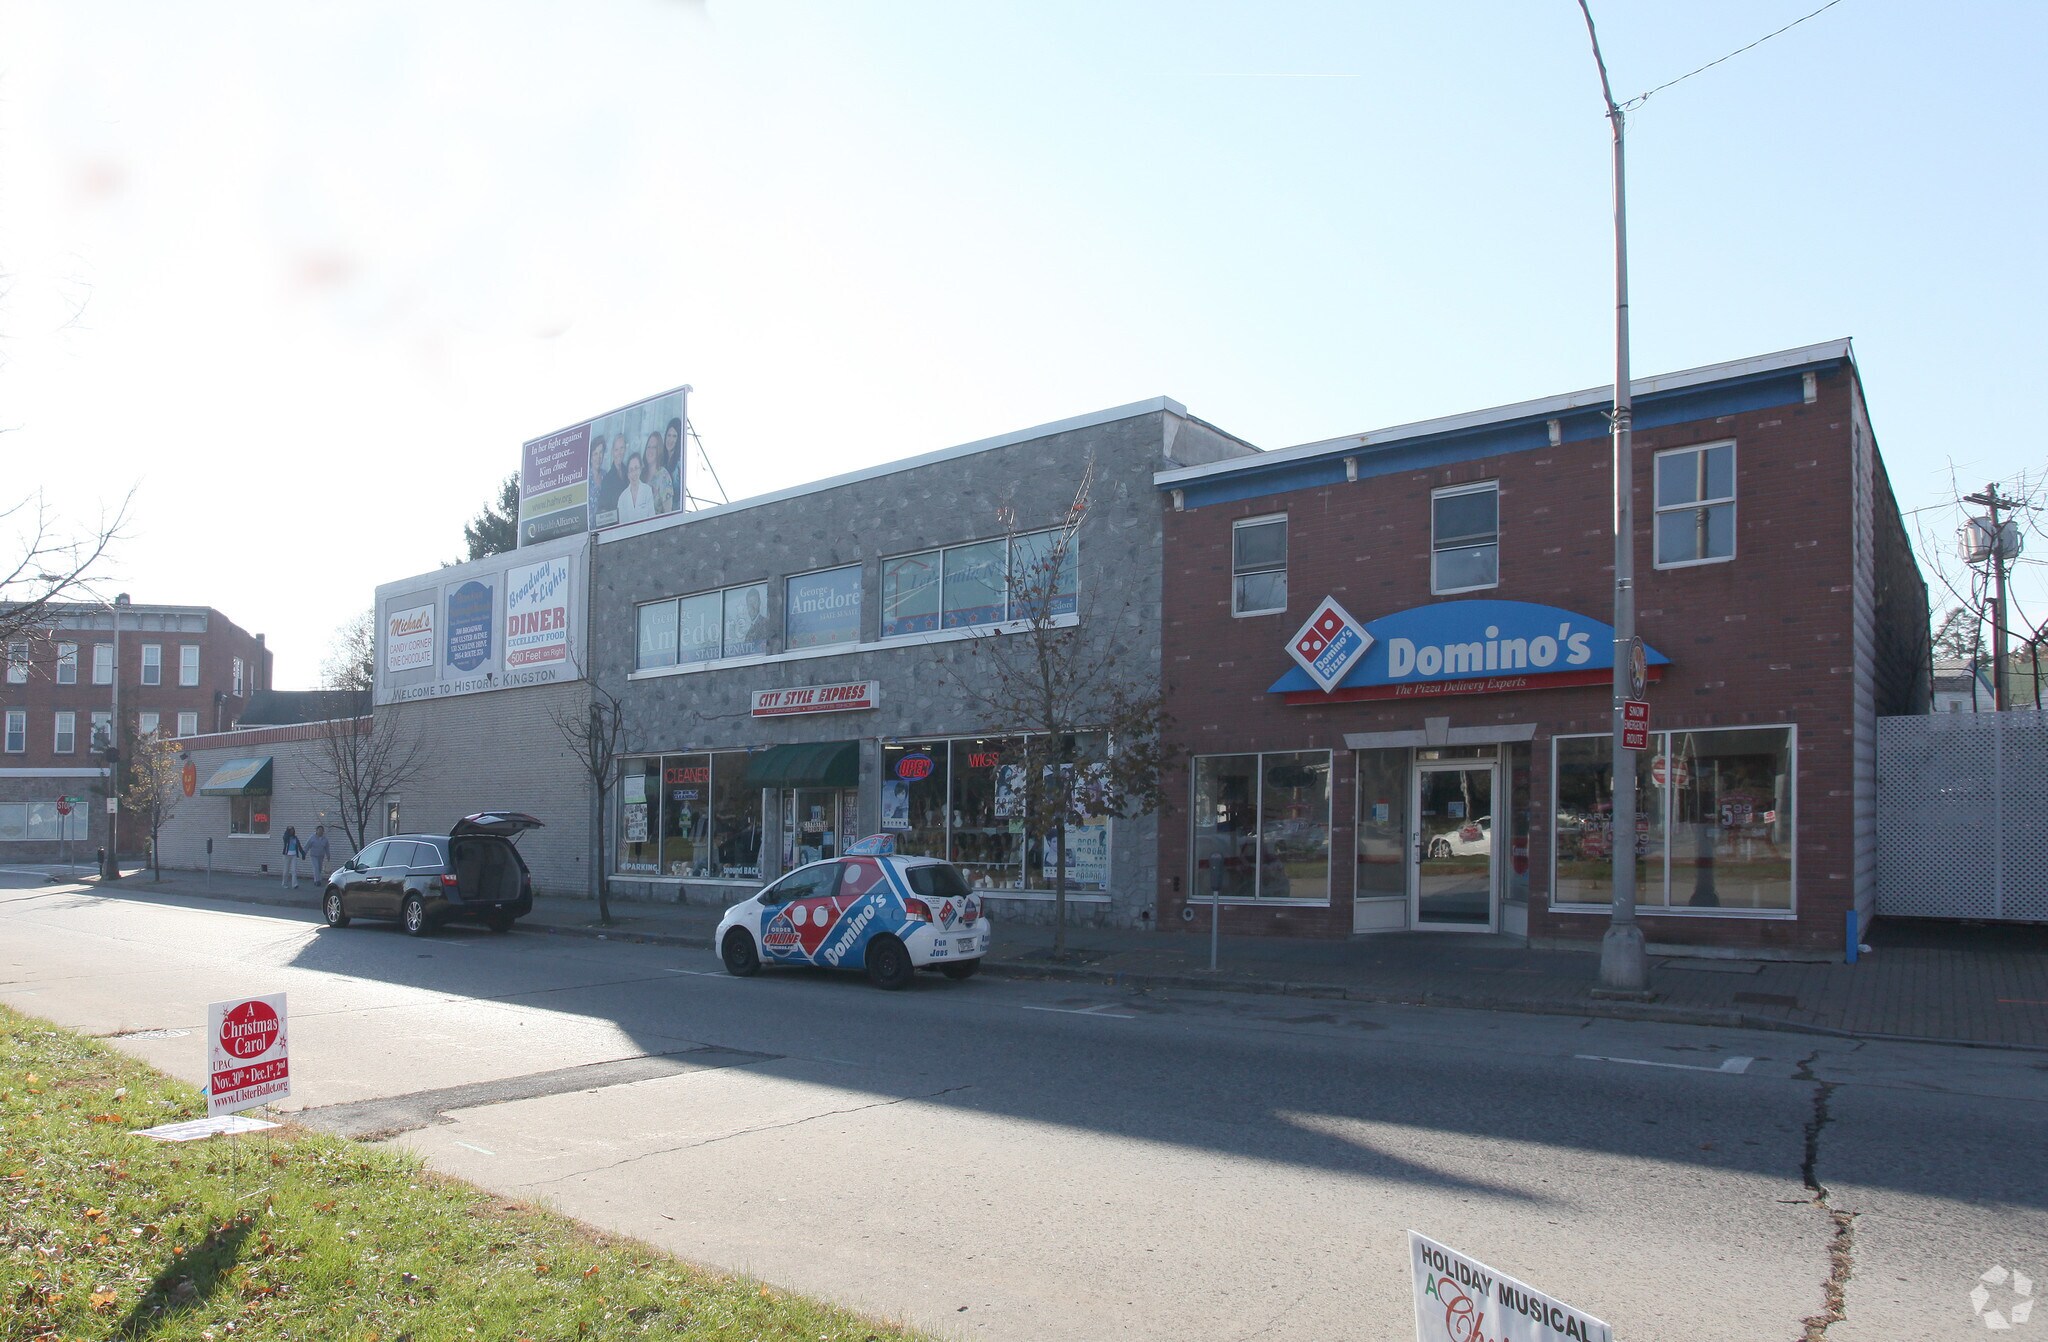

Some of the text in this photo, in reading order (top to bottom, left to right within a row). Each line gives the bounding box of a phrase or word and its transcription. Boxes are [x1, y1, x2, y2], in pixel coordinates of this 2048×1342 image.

[531, 432, 582, 455] In her fight against
[536, 456, 551, 466] breast
[526, 467, 583, 494] Benedictine Hospital
[540, 466, 552, 478] Kim
[509, 561, 550, 610] Broadway
[540, 567, 566, 602] Lights
[800, 586, 828, 598] George
[792, 588, 860, 614] Amedore
[390, 610, 430, 637] Michael's
[508, 606, 565, 637] DINER
[390, 638, 432, 654] CANDY CORNER
[508, 630, 565, 648] EXCELLENT FOOD
[391, 650, 430, 667] FINE CHOCOLATE
[512, 652, 524, 664] 500
[526, 650, 541, 660] Feet
[550, 647, 564, 657] Right
[696, 642, 755, 660] STATE SENATE
[1316, 630, 1352, 670] Domino's
[1388, 622, 1590, 678] Domino's
[1322, 652, 1346, 678] Pizza
[393, 686, 435, 700] WELCOME
[440, 684, 450, 694] TO
[503, 669, 556, 686] KINGSTON
[1395, 677, 1526, 695] The Pizza Delivery Experts
[759, 685, 866, 707] CITY STYLE EXPRESS
[1629, 706, 1644, 717] SNOW
[1626, 733, 1643, 745] ROUTE
[900, 759, 930, 778] OPEN
[968, 752, 1000, 768] WIGS
[627, 863, 658, 872] PARKING
[744, 866, 760, 874] BACK
[764, 933, 800, 944] ONLINE
[824, 894, 886, 966] Domino's
[934, 939, 946, 947] Fun
[247, 1002, 254, 1017] A
[220, 1017, 278, 1040] Christmas
[234, 1033, 266, 1056] Carol
[213, 1058, 234, 1072] UPAC
[214, 1081, 288, 1108] www.UlsterBallet.org
[1421, 1243, 1493, 1298] HOLIDAY
[1498, 1282, 1592, 1342] MUSICAL
[1424, 1272, 1439, 1301] A
